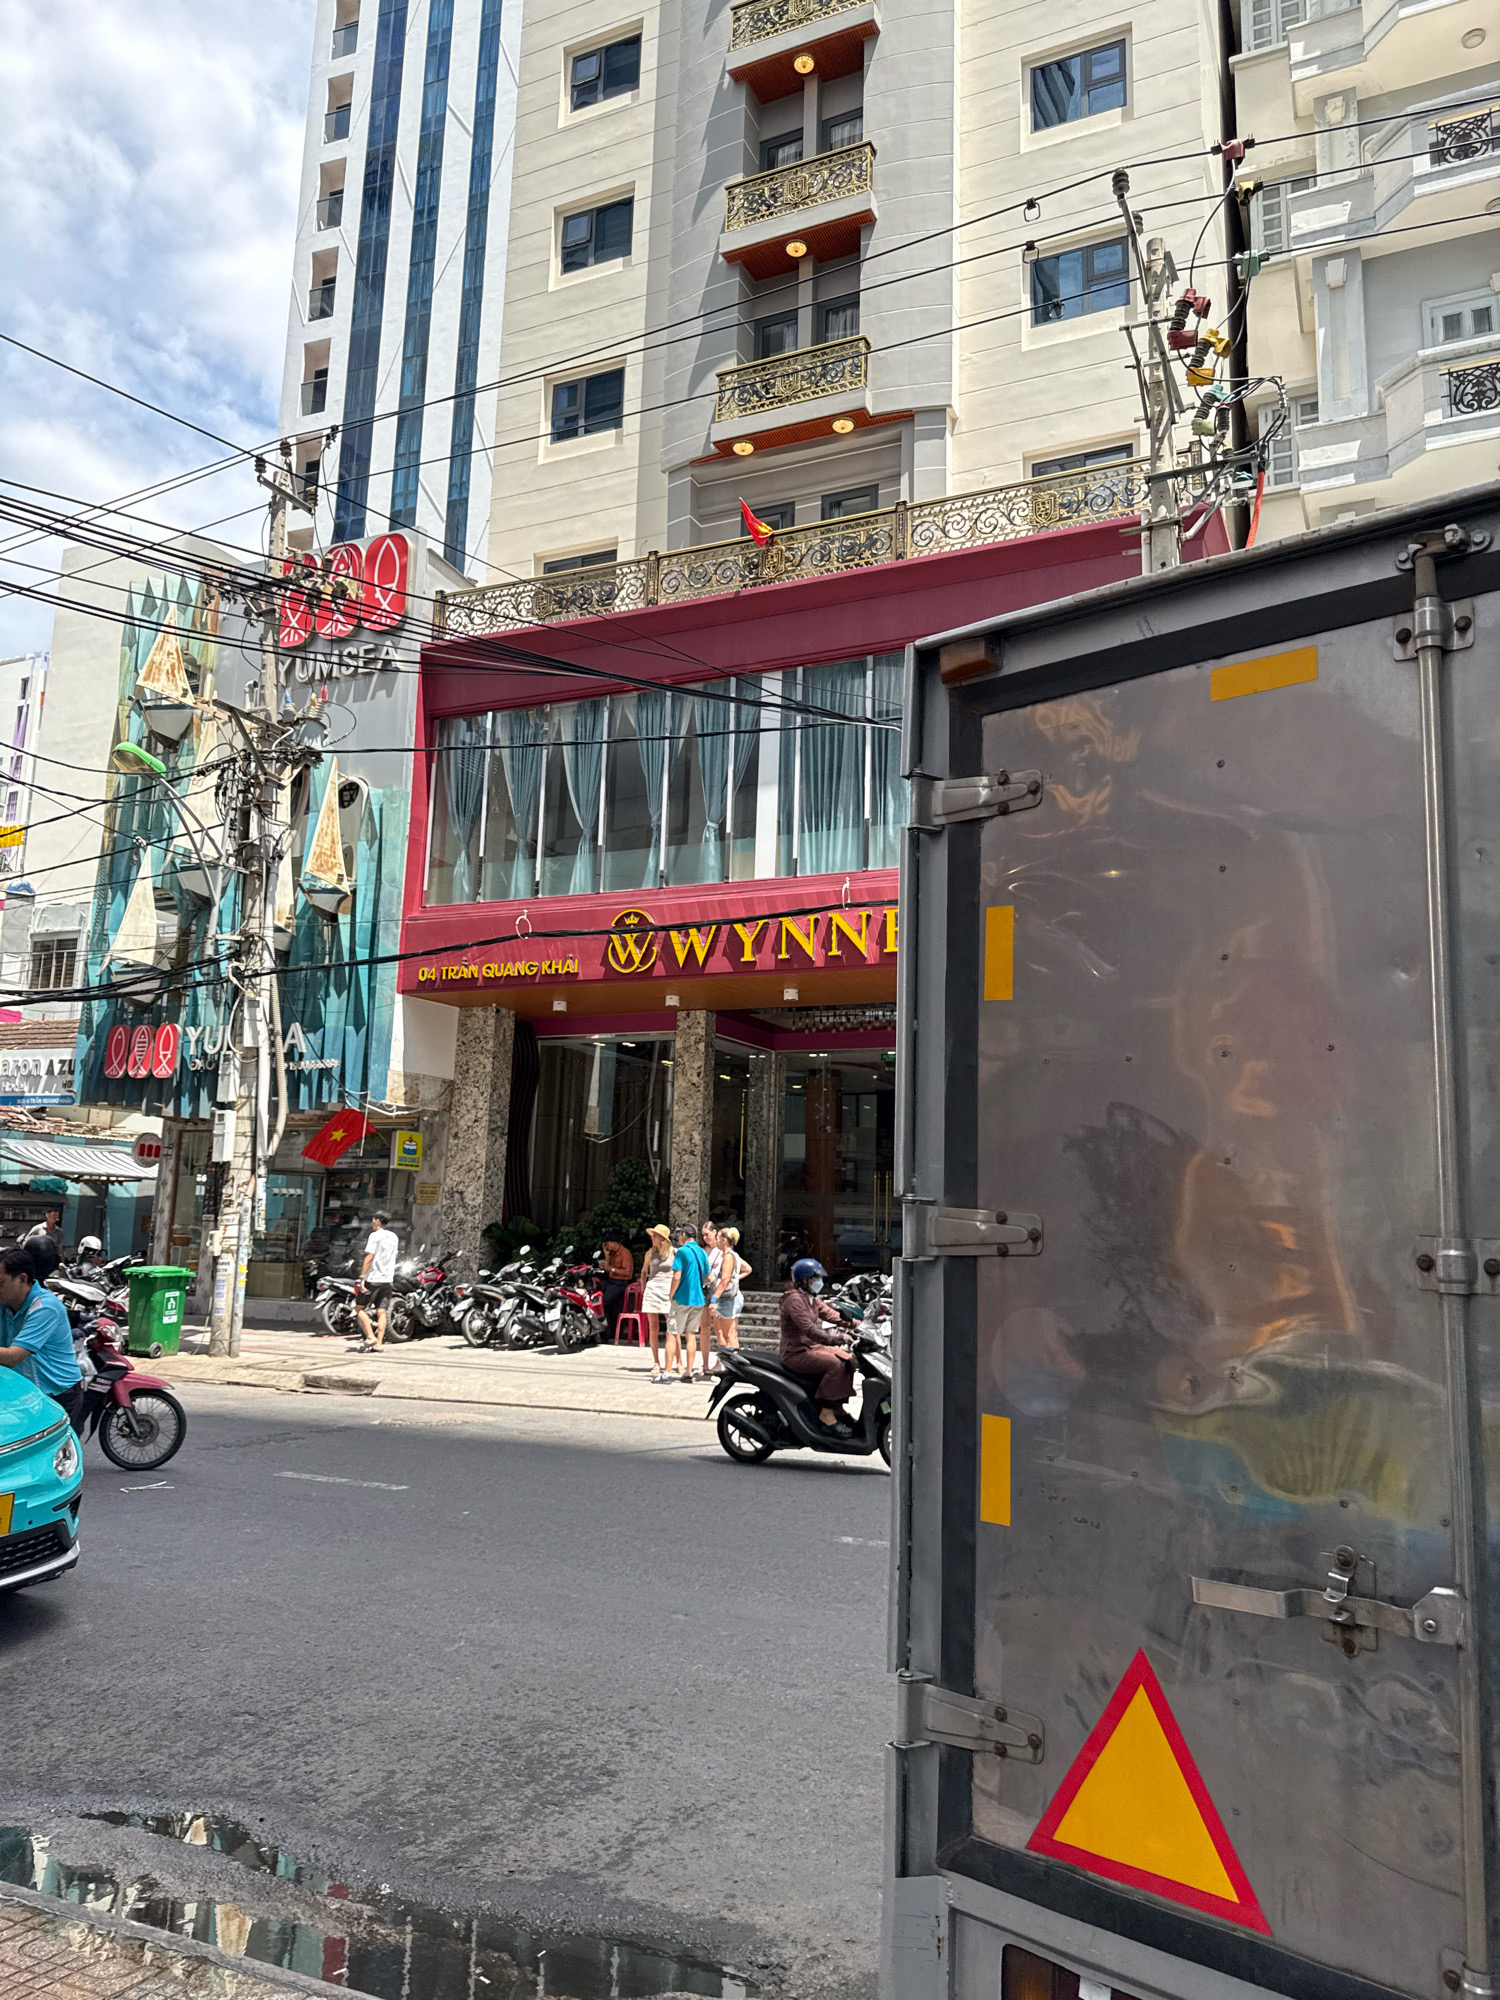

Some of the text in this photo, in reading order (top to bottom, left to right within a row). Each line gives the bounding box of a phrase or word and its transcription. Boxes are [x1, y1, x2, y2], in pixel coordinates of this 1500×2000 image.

[278, 640, 400, 685] YUMSEA
[418, 967, 436, 982] 04
[482, 961, 538, 978] QUANG
[185, 1022, 307, 1055] YUA
